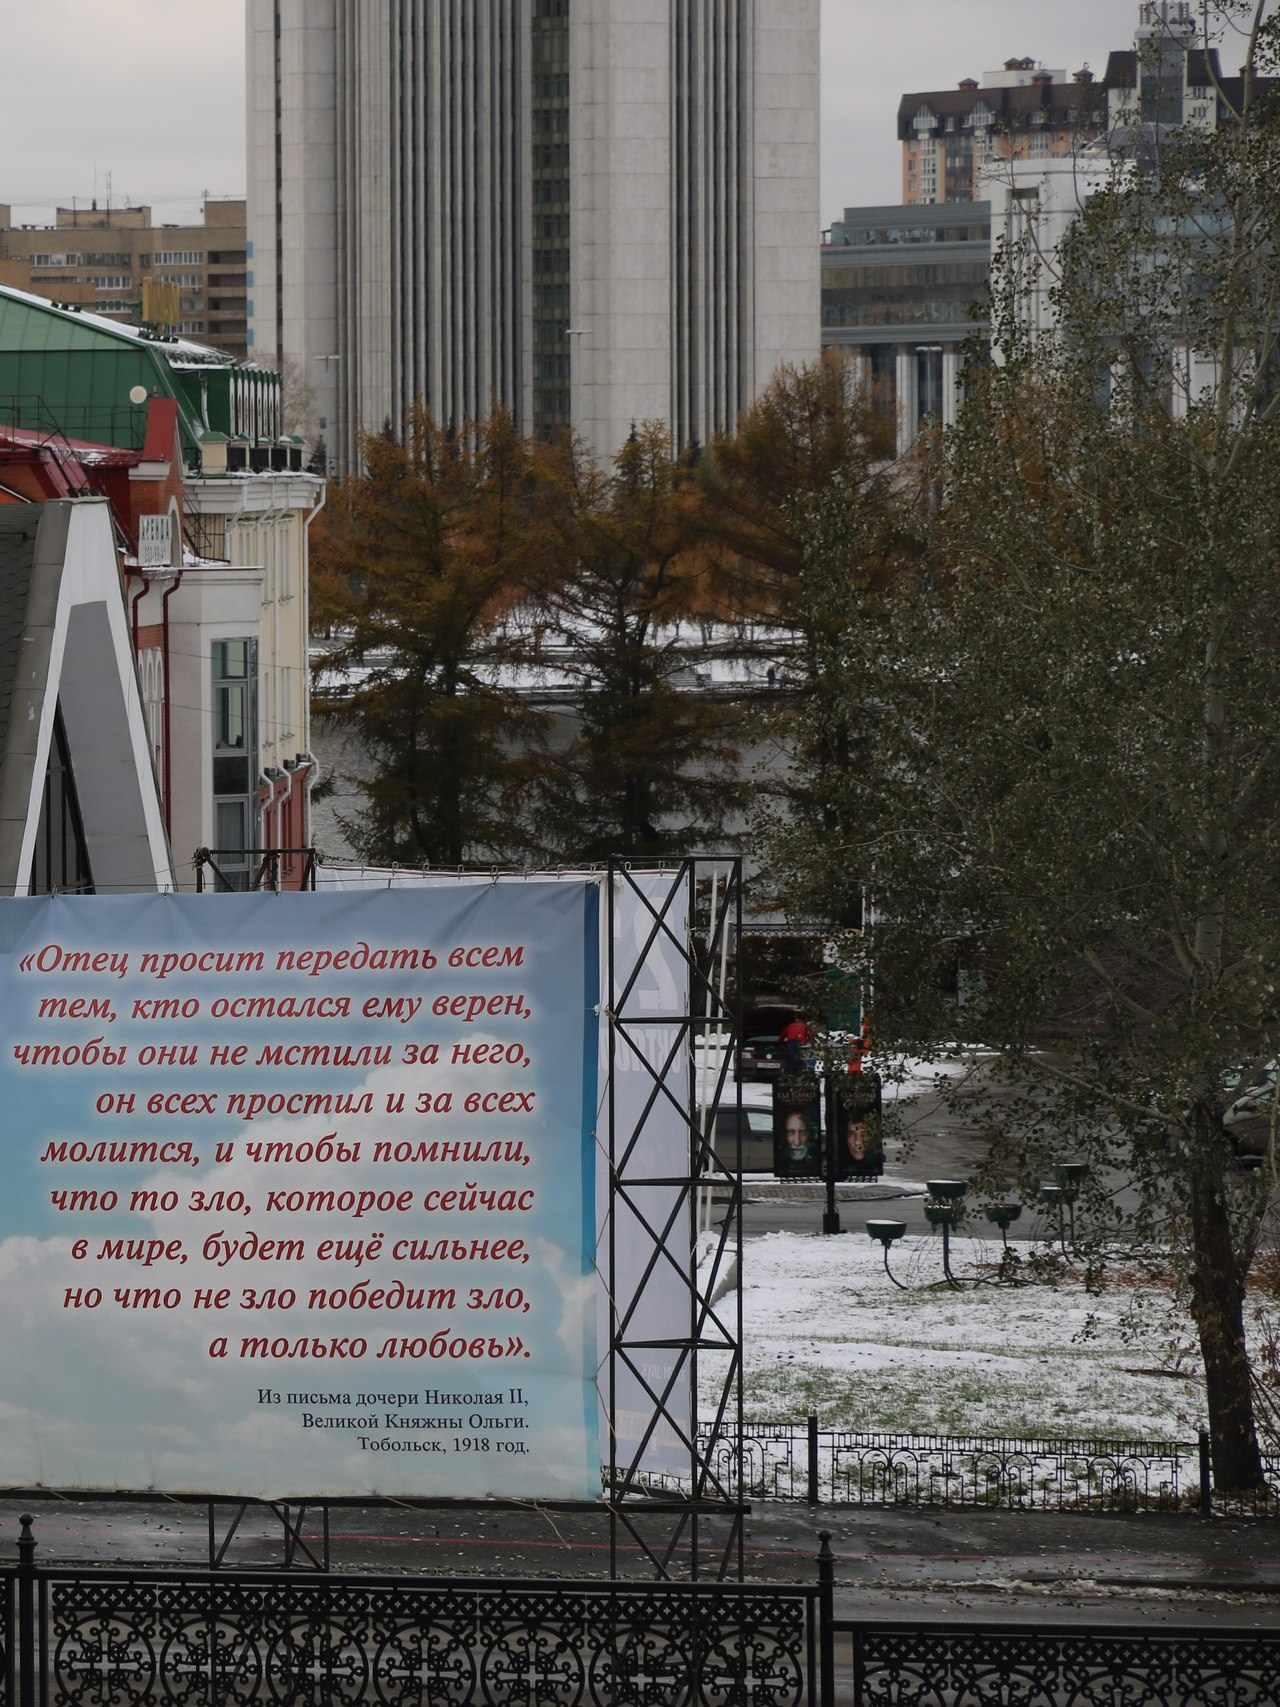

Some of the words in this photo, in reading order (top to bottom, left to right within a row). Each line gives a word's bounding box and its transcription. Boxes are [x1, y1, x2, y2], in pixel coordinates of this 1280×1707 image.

[19, 944, 129, 977] «Отец
[140, 951, 264, 979] просит
[276, 942, 438, 977] передать
[447, 946, 524, 968] всем
[38, 998, 117, 1022] тем,
[132, 998, 200, 1019] кто
[210, 997, 351, 1018] остался
[362, 997, 422, 1024] ему
[432, 994, 532, 1022] верен,
[14, 1037, 127, 1066] чтобы
[138, 1045, 198, 1066] они
[210, 1045, 249, 1066] не
[255, 1045, 392, 1067] мстили
[402, 1043, 439, 1065] за
[451, 1043, 531, 1069] него,
[96, 1093, 136, 1114] он
[147, 1093, 218, 1114] всех
[226, 1092, 373, 1121] простил
[385, 1092, 405, 1114] и
[415, 1092, 453, 1114] за
[463, 1091, 536, 1113] всех
[40, 1141, 200, 1166] молится,
[215, 1142, 233, 1163] и
[246, 1132, 361, 1163] чтобы
[373, 1141, 530, 1165] помнили,
[51, 1190, 118, 1212] что
[129, 1190, 179, 1212] то
[189, 1190, 252, 1214] зло,
[266, 1190, 414, 1217] которое
[423, 1183, 535, 1212] сейчас
[71, 1239, 89, 1260] в
[96, 1239, 188, 1267] мире,
[202, 1231, 305, 1268] будет
[316, 1232, 385, 1266] ещё
[392, 1239, 529, 1264] сильнее,
[63, 1287, 103, 1309] но
[114, 1288, 182, 1309] что
[193, 1288, 231, 1310] не
[240, 1288, 297, 1310] зло
[308, 1279, 456, 1310] победит
[466, 1288, 531, 1311] зло,
[208, 1337, 228, 1358] а
[239, 1337, 368, 1359] только
[376, 1328, 531, 1359] любовь».
[257, 1388, 282, 1405] Из
[286, 1393, 352, 1405] письма
[355, 1393, 419, 1408] дочери
[423, 1389, 504, 1405] Николая
[508, 1388, 529, 1407] II,
[301, 1412, 379, 1429] Великой
[384, 1413, 464, 1429] Княжны
[468, 1413, 529, 1429] Ольги.
[356, 1436, 447, 1455] Тобольск,
[453, 1437, 490, 1452] 1918
[495, 1441, 530, 1455] год.
